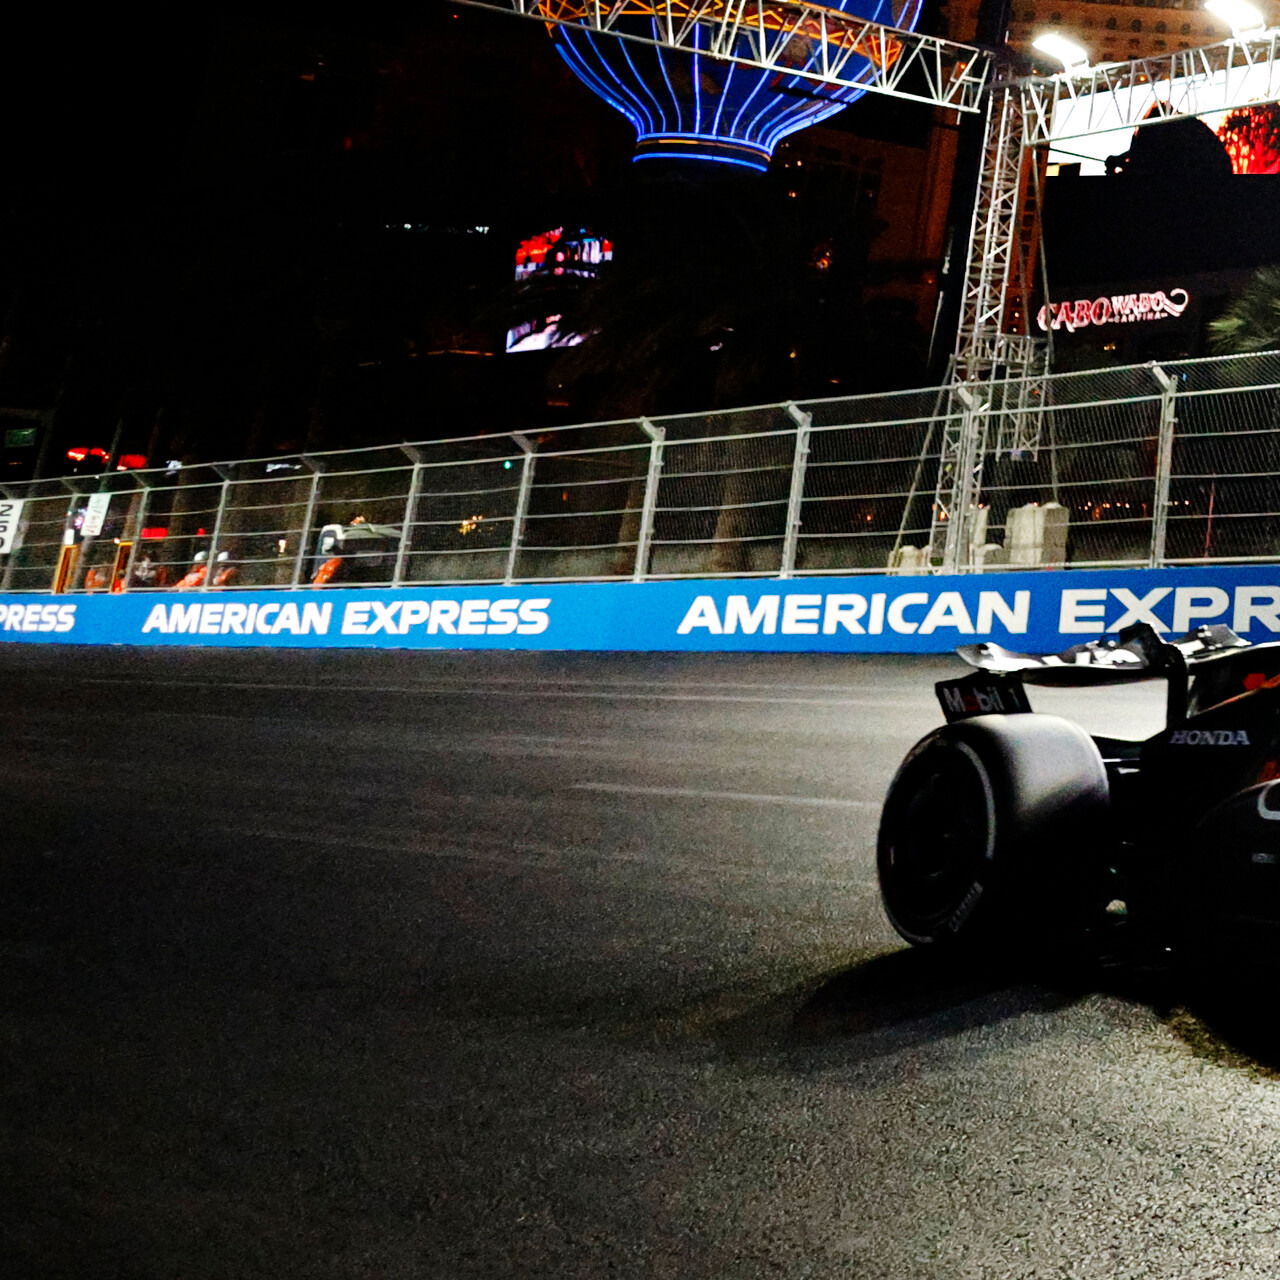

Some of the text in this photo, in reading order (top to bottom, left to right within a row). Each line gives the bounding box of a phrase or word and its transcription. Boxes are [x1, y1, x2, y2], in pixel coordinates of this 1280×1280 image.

[1037, 288, 1188, 332] CABO WABO
[142, 599, 551, 635] AMERICAN EXPRESS
[677, 590, 1030, 634] AMERICAN
[945, 685, 1004, 715] Mobil
[1169, 730, 1251, 746] HONDA
